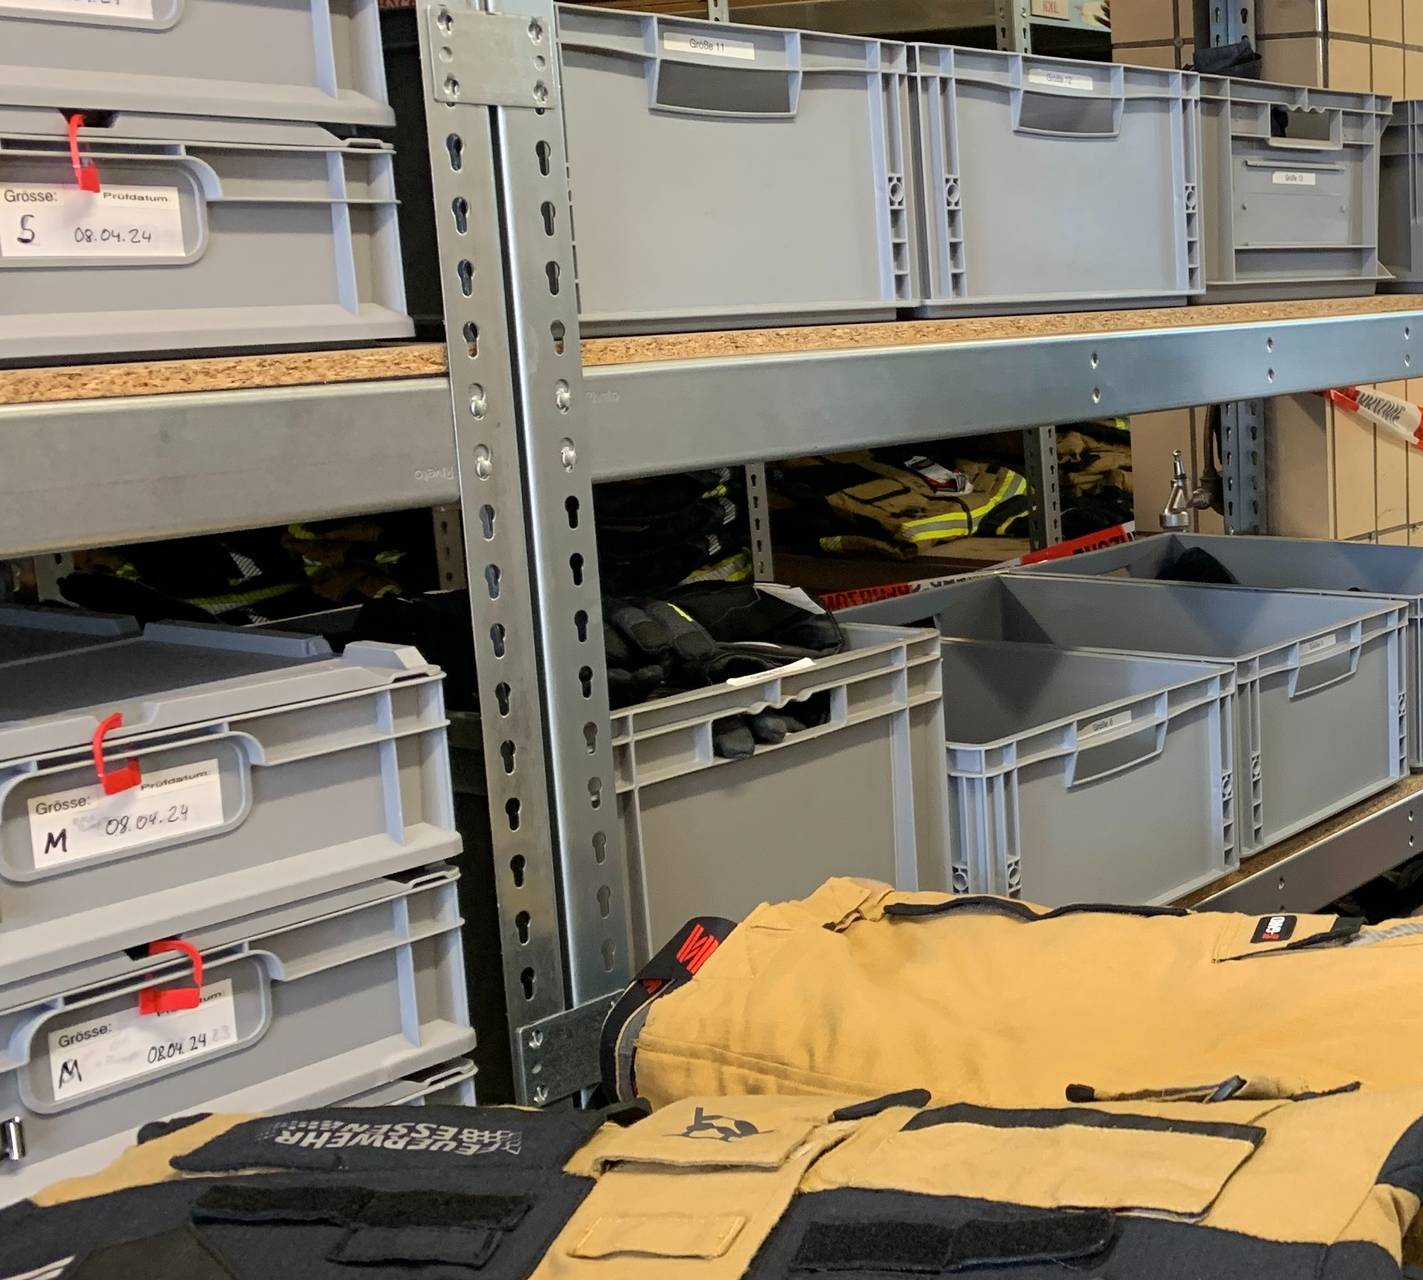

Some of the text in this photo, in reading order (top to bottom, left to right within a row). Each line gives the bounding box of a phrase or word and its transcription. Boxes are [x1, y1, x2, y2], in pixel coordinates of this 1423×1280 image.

[716, 42, 725, 52] 11
[17, 214, 152, 244] S 08.04.24
[35, 795, 91, 816] Grösse:
[44, 828, 68, 854] M
[58, 1022, 113, 1048] Grösse:
[58, 1059, 82, 1089] M
[340, 1121, 455, 1135] ESSEN
